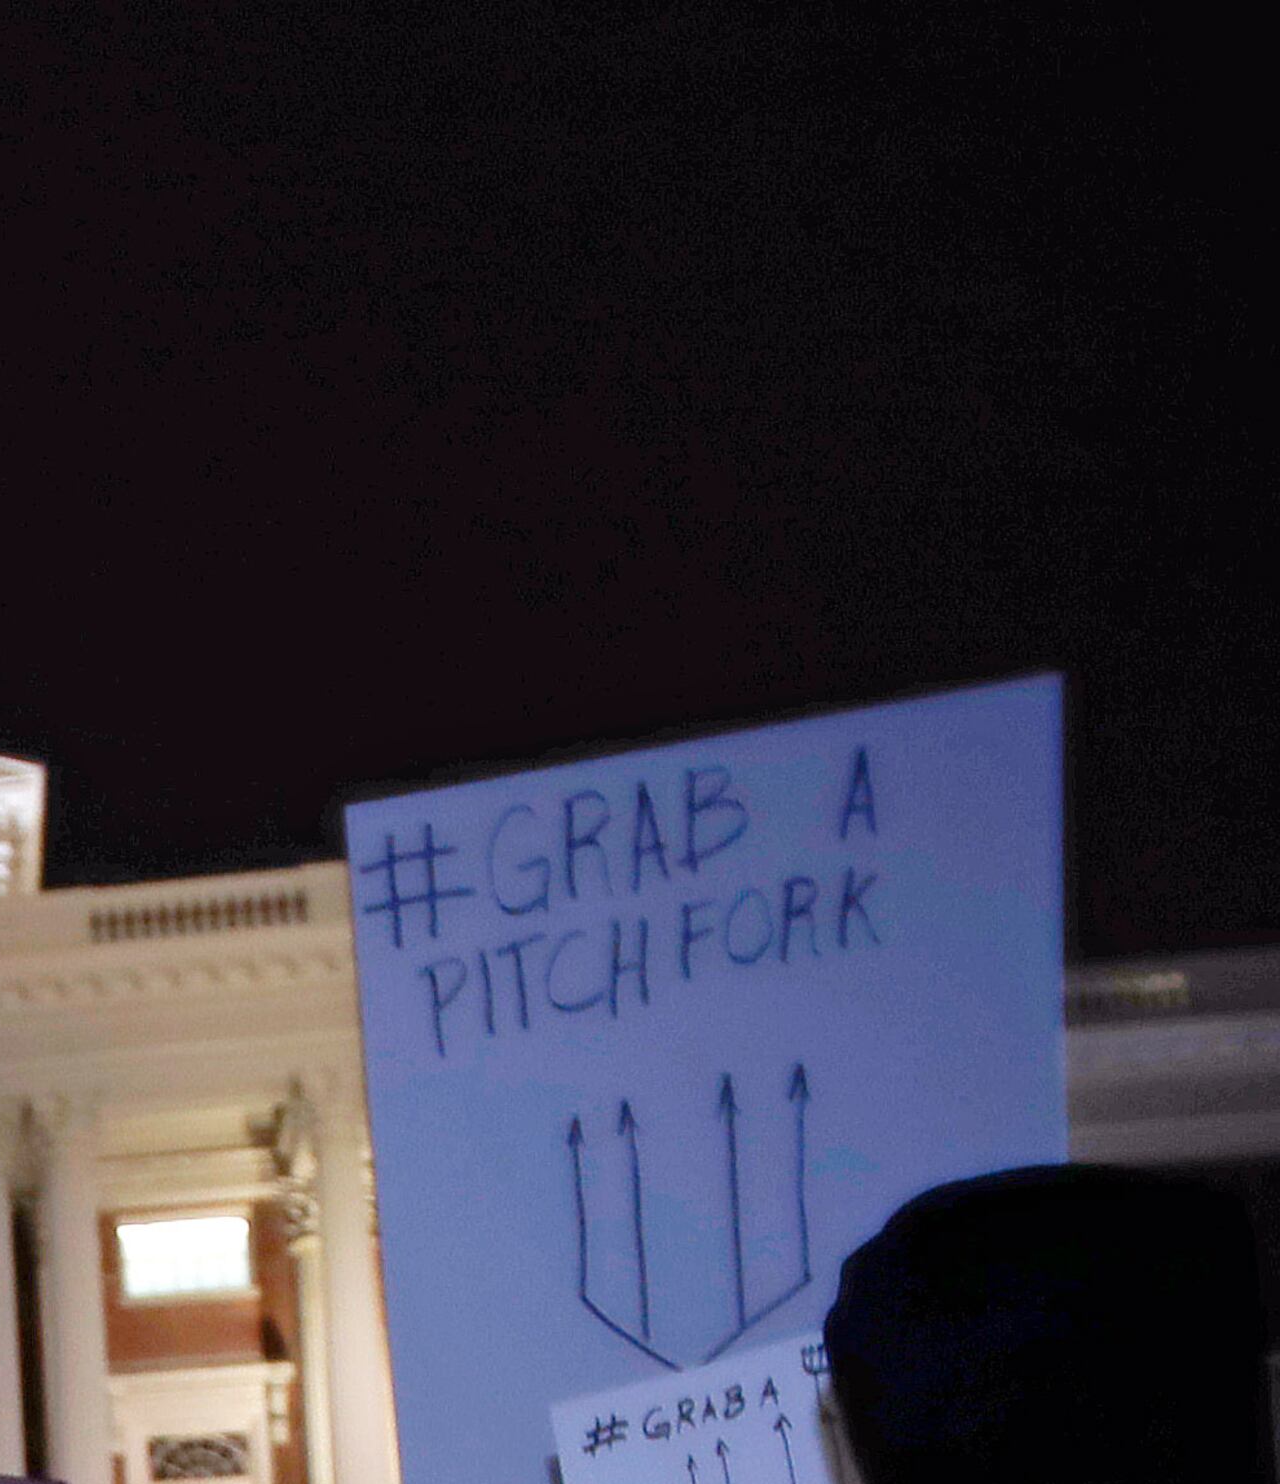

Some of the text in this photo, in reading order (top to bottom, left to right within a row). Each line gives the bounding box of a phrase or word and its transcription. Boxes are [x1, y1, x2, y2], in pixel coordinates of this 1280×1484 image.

[360, 744, 878, 949] #GRAB A
[583, 1375, 780, 1457] #GRAB A
